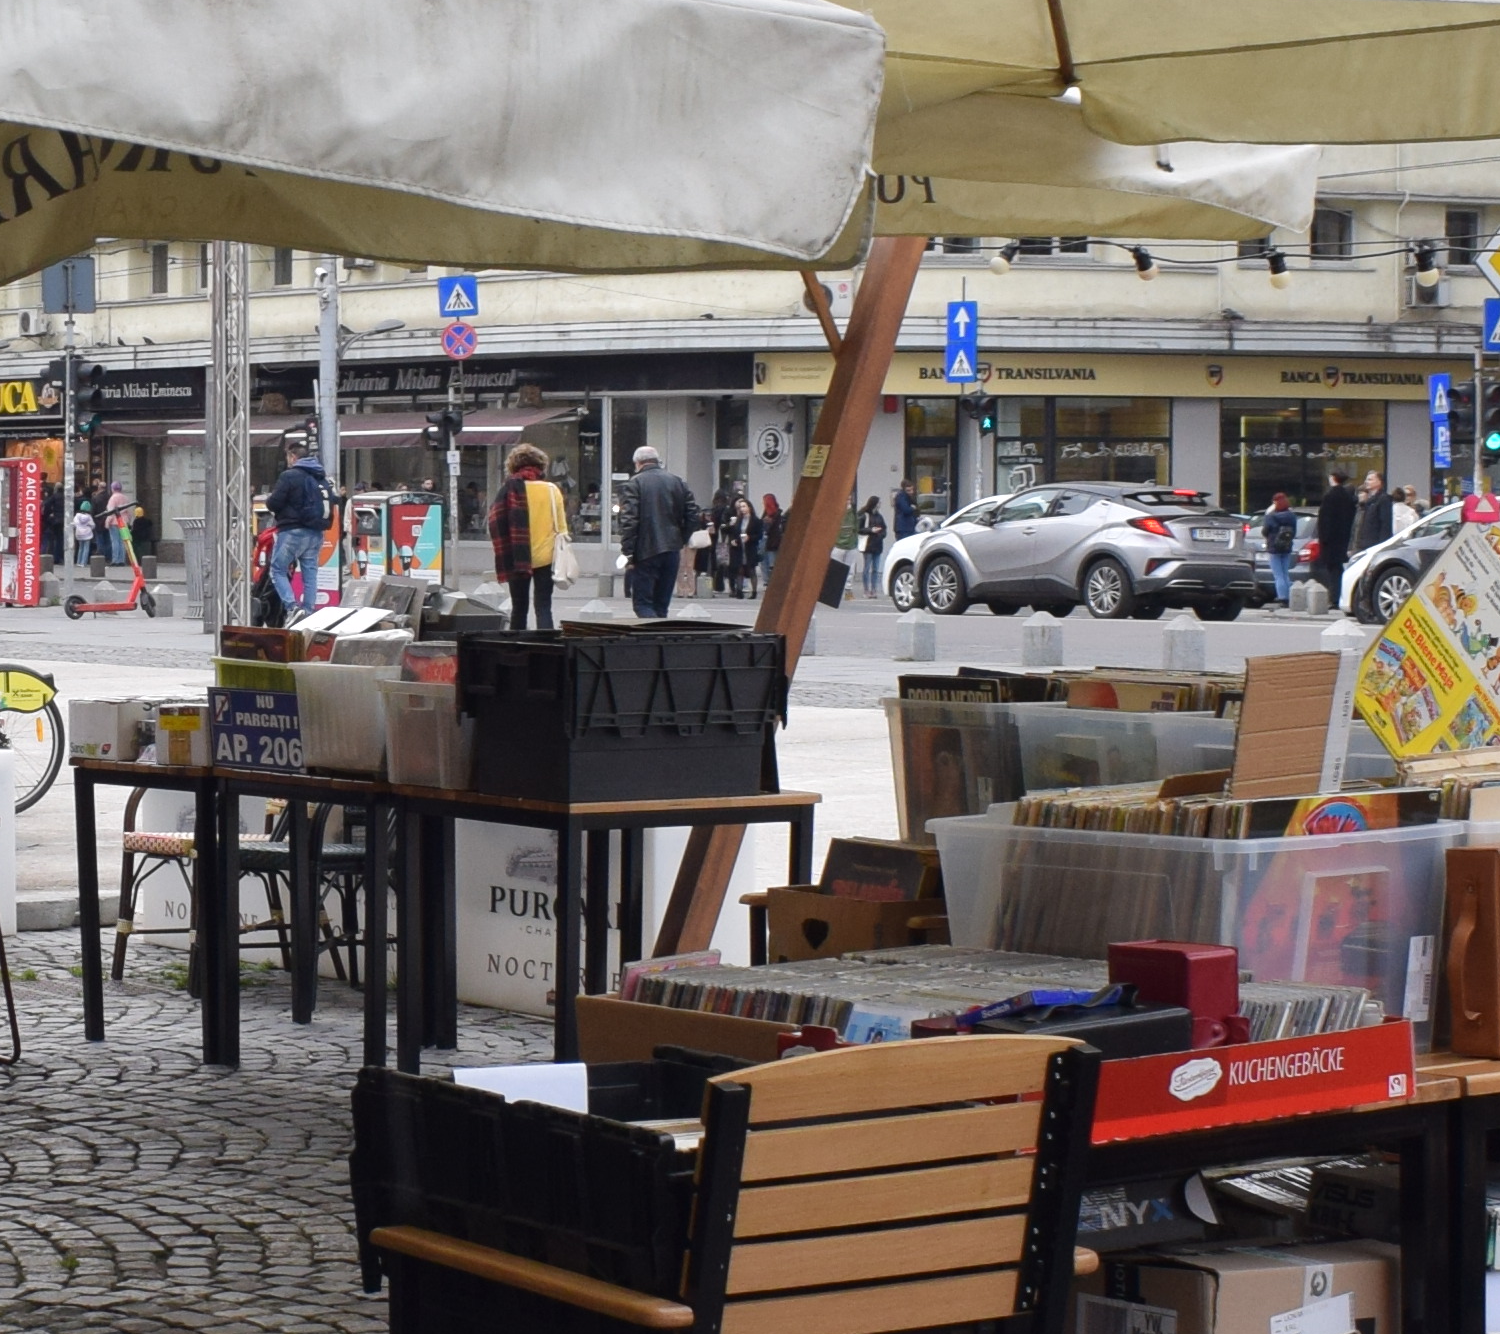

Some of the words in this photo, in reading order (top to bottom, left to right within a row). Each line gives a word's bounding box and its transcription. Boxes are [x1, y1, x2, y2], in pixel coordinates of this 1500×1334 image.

[395, 367, 442, 391] Mihai
[919, 367, 946, 380] BAN
[997, 367, 1097, 381] TRANSILVANIA
[1280, 371, 1321, 384] BANCA
[1342, 371, 1424, 386] TRANSILVANIA
[123, 381, 150, 398] Mihai
[151, 381, 193, 398] Eminescu
[26, 476, 37, 500] AICI
[25, 503, 37, 545] Cartela
[24, 547, 35, 601] Vodafone
[1403, 616, 1418, 636] Die
[1414, 631, 1437, 665] Biene
[1433, 660, 1455, 691] Maja
[256, 695, 275, 709] NU
[217, 736, 252, 763] AP.
[258, 736, 302, 768] 206
[1228, 1047, 1346, 1086] KUCHENGEBÄCKE
